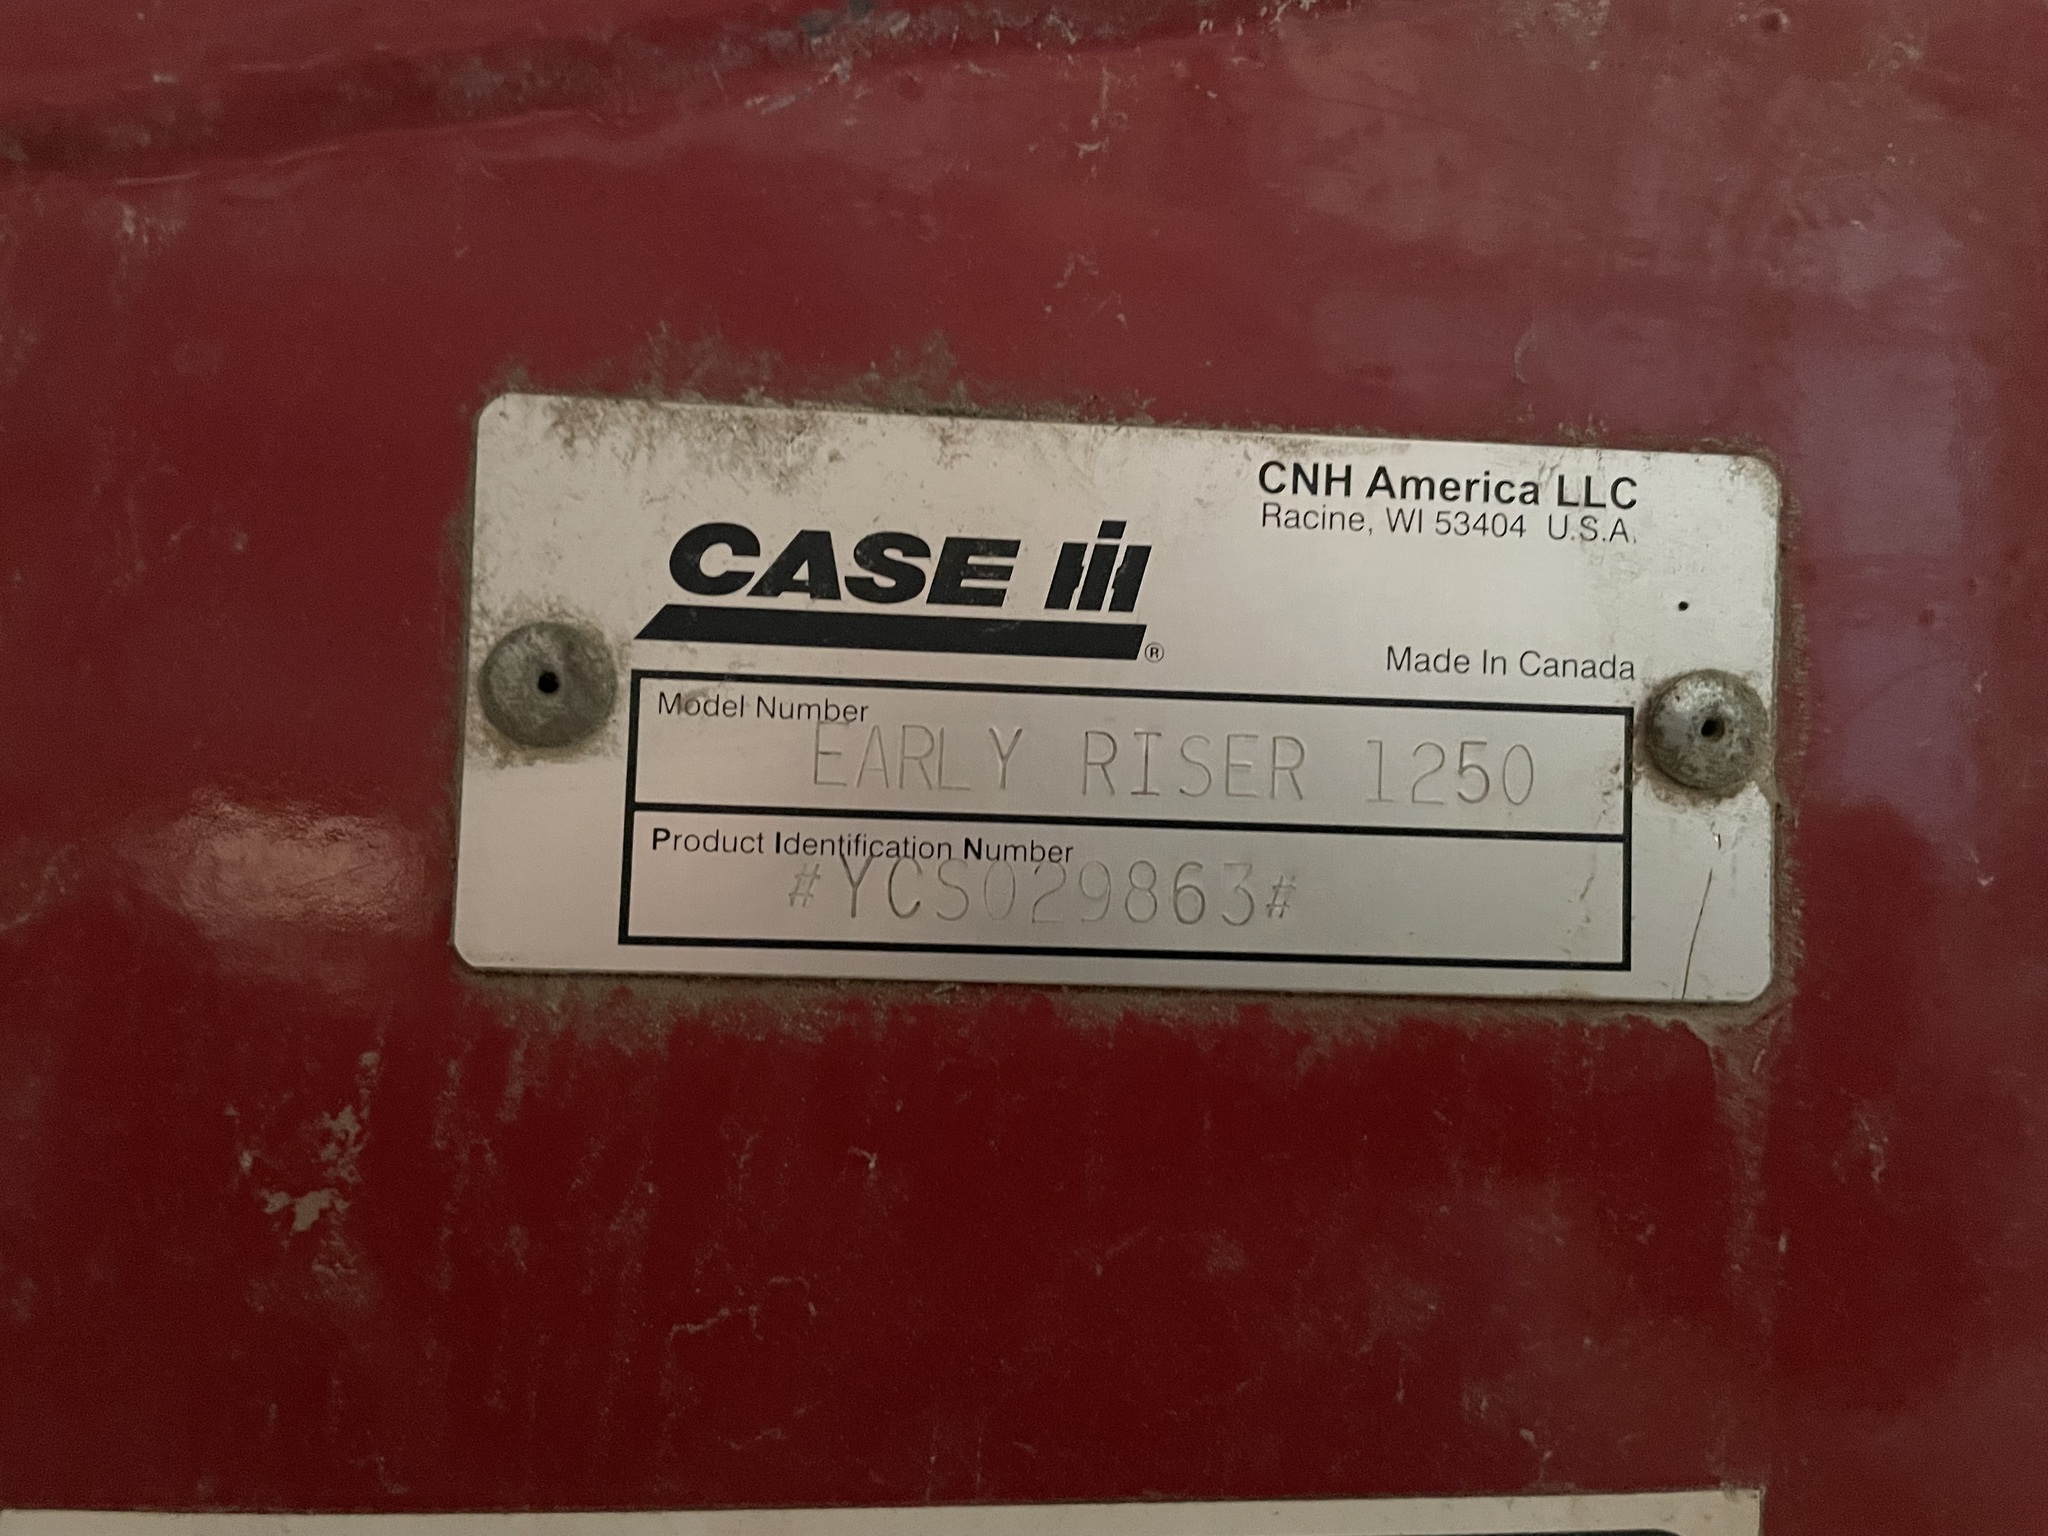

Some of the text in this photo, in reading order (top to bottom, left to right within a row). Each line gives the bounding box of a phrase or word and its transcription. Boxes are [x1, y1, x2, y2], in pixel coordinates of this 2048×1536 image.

[1258, 461, 1639, 510] CNH America LLC
[1261, 502, 1638, 544] Racine, WI 53404 U.S.A.
[669, 522, 1021, 608] CASE
[1386, 646, 1636, 682] Made In Canada
[657, 691, 870, 723] Model Number
[813, 720, 1535, 806] EARLY RISER 1250
[651, 827, 1075, 864] Product Identification Number
[788, 854, 1297, 927] #YCS029863#
